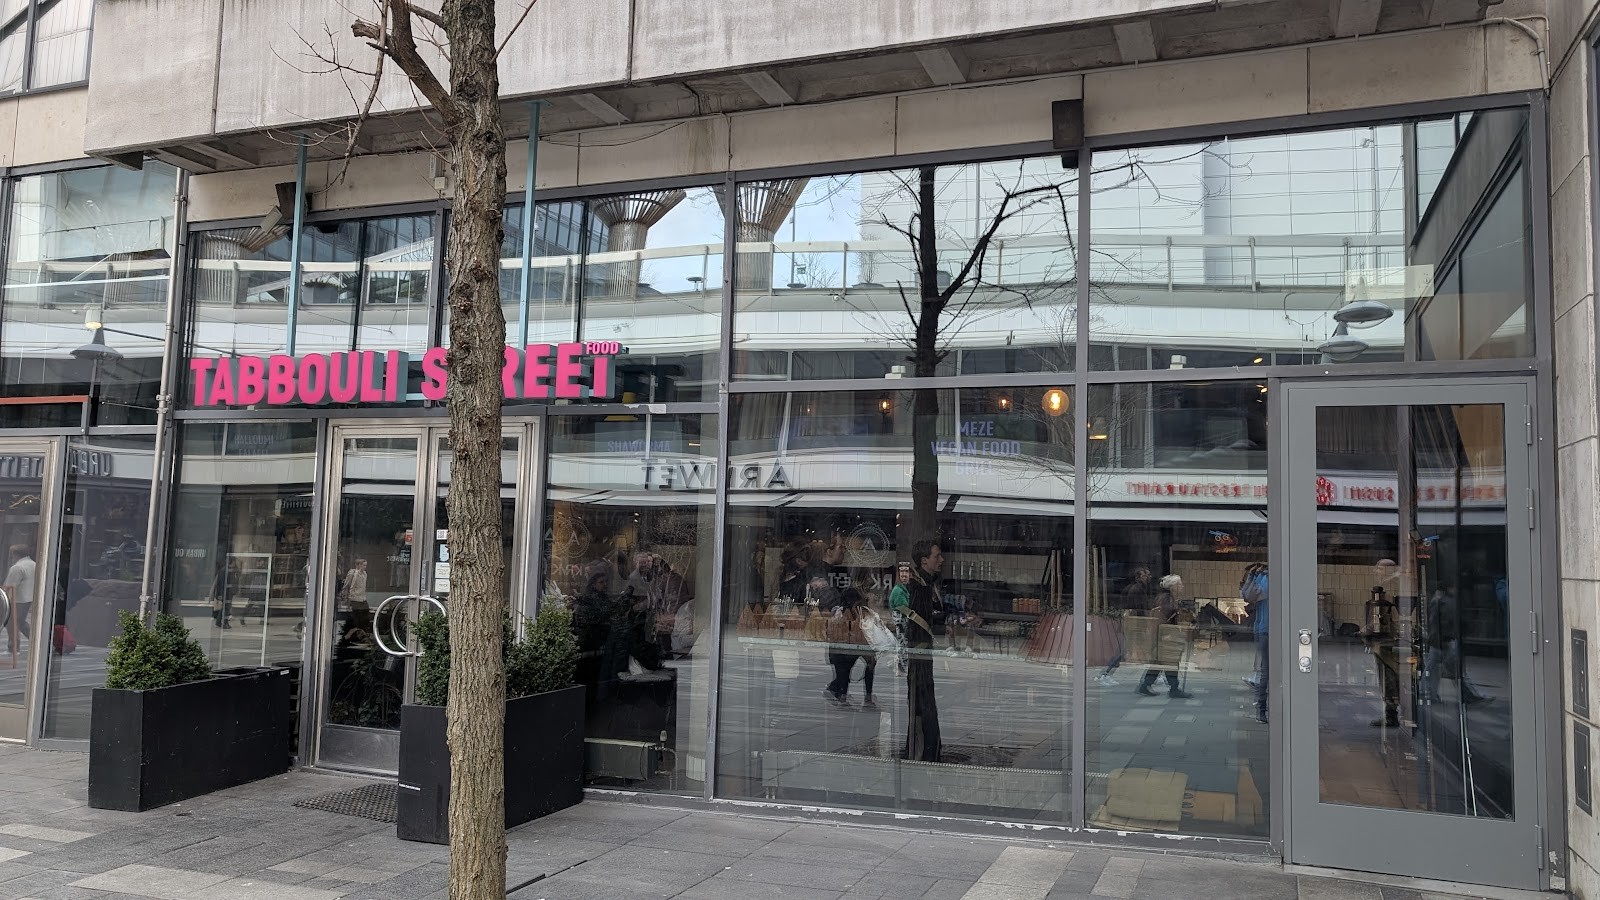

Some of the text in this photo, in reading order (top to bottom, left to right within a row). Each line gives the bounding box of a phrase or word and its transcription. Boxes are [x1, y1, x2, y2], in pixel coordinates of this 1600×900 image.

[586, 341, 619, 355] FOOD
[189, 343, 608, 406] TABBOULI SREET
[959, 421, 994, 436] MEZE
[930, 441, 1021, 456] VEGAN FOOD
